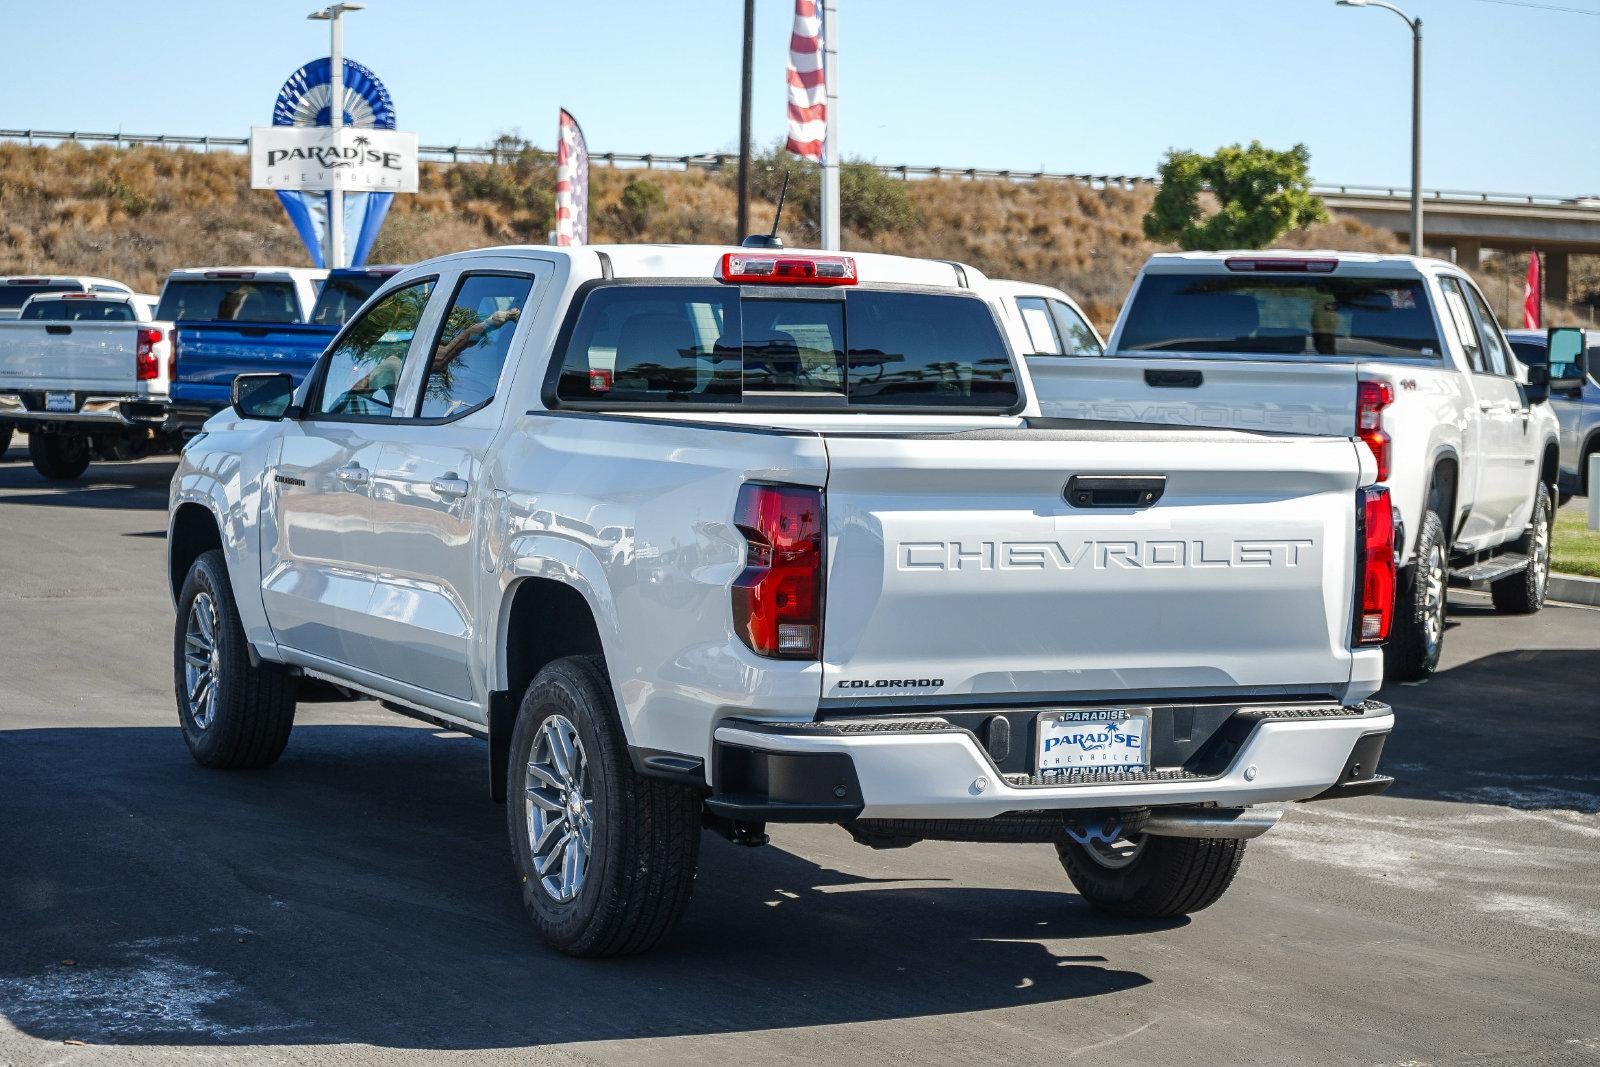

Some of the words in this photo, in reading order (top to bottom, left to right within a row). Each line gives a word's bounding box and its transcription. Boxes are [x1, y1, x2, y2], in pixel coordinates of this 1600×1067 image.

[268, 136, 402, 170] PARADISE
[267, 173, 402, 189] CHEVROLET
[897, 540, 1312, 570] CHEVROLET
[838, 678, 944, 688] COLORADO
[1065, 711, 1125, 720] PARADISE
[1045, 722, 1140, 752] PARADISE
[1043, 753, 1140, 766] CHEVROLET
[1063, 766, 1125, 777] VENTURA
